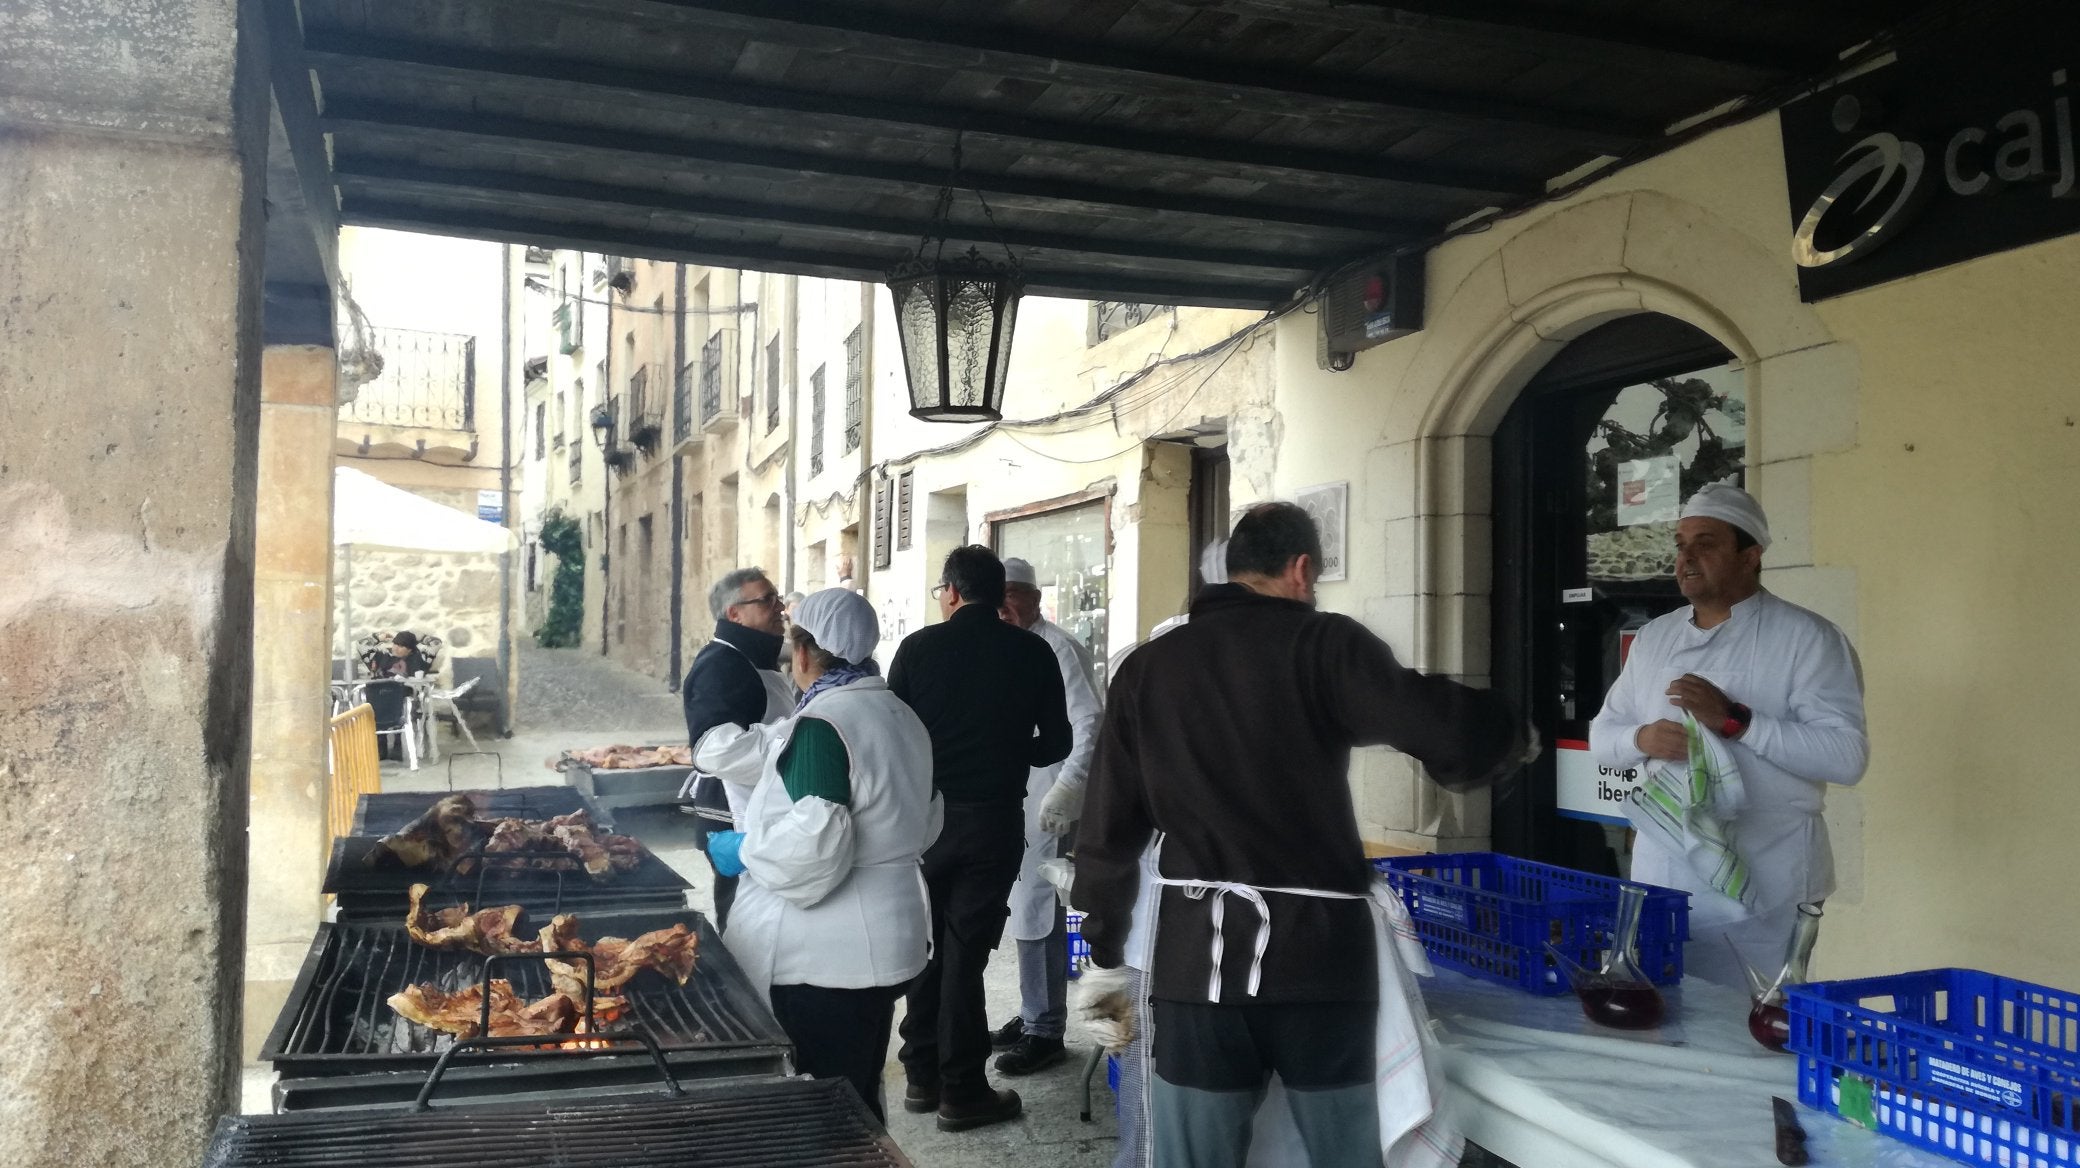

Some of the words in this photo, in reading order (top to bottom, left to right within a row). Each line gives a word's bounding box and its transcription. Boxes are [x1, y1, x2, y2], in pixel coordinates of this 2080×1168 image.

[1961, 1066, 1970, 1077] DE
[1970, 1069, 1986, 1082] AVES
[1987, 1073, 1992, 1083] Y
